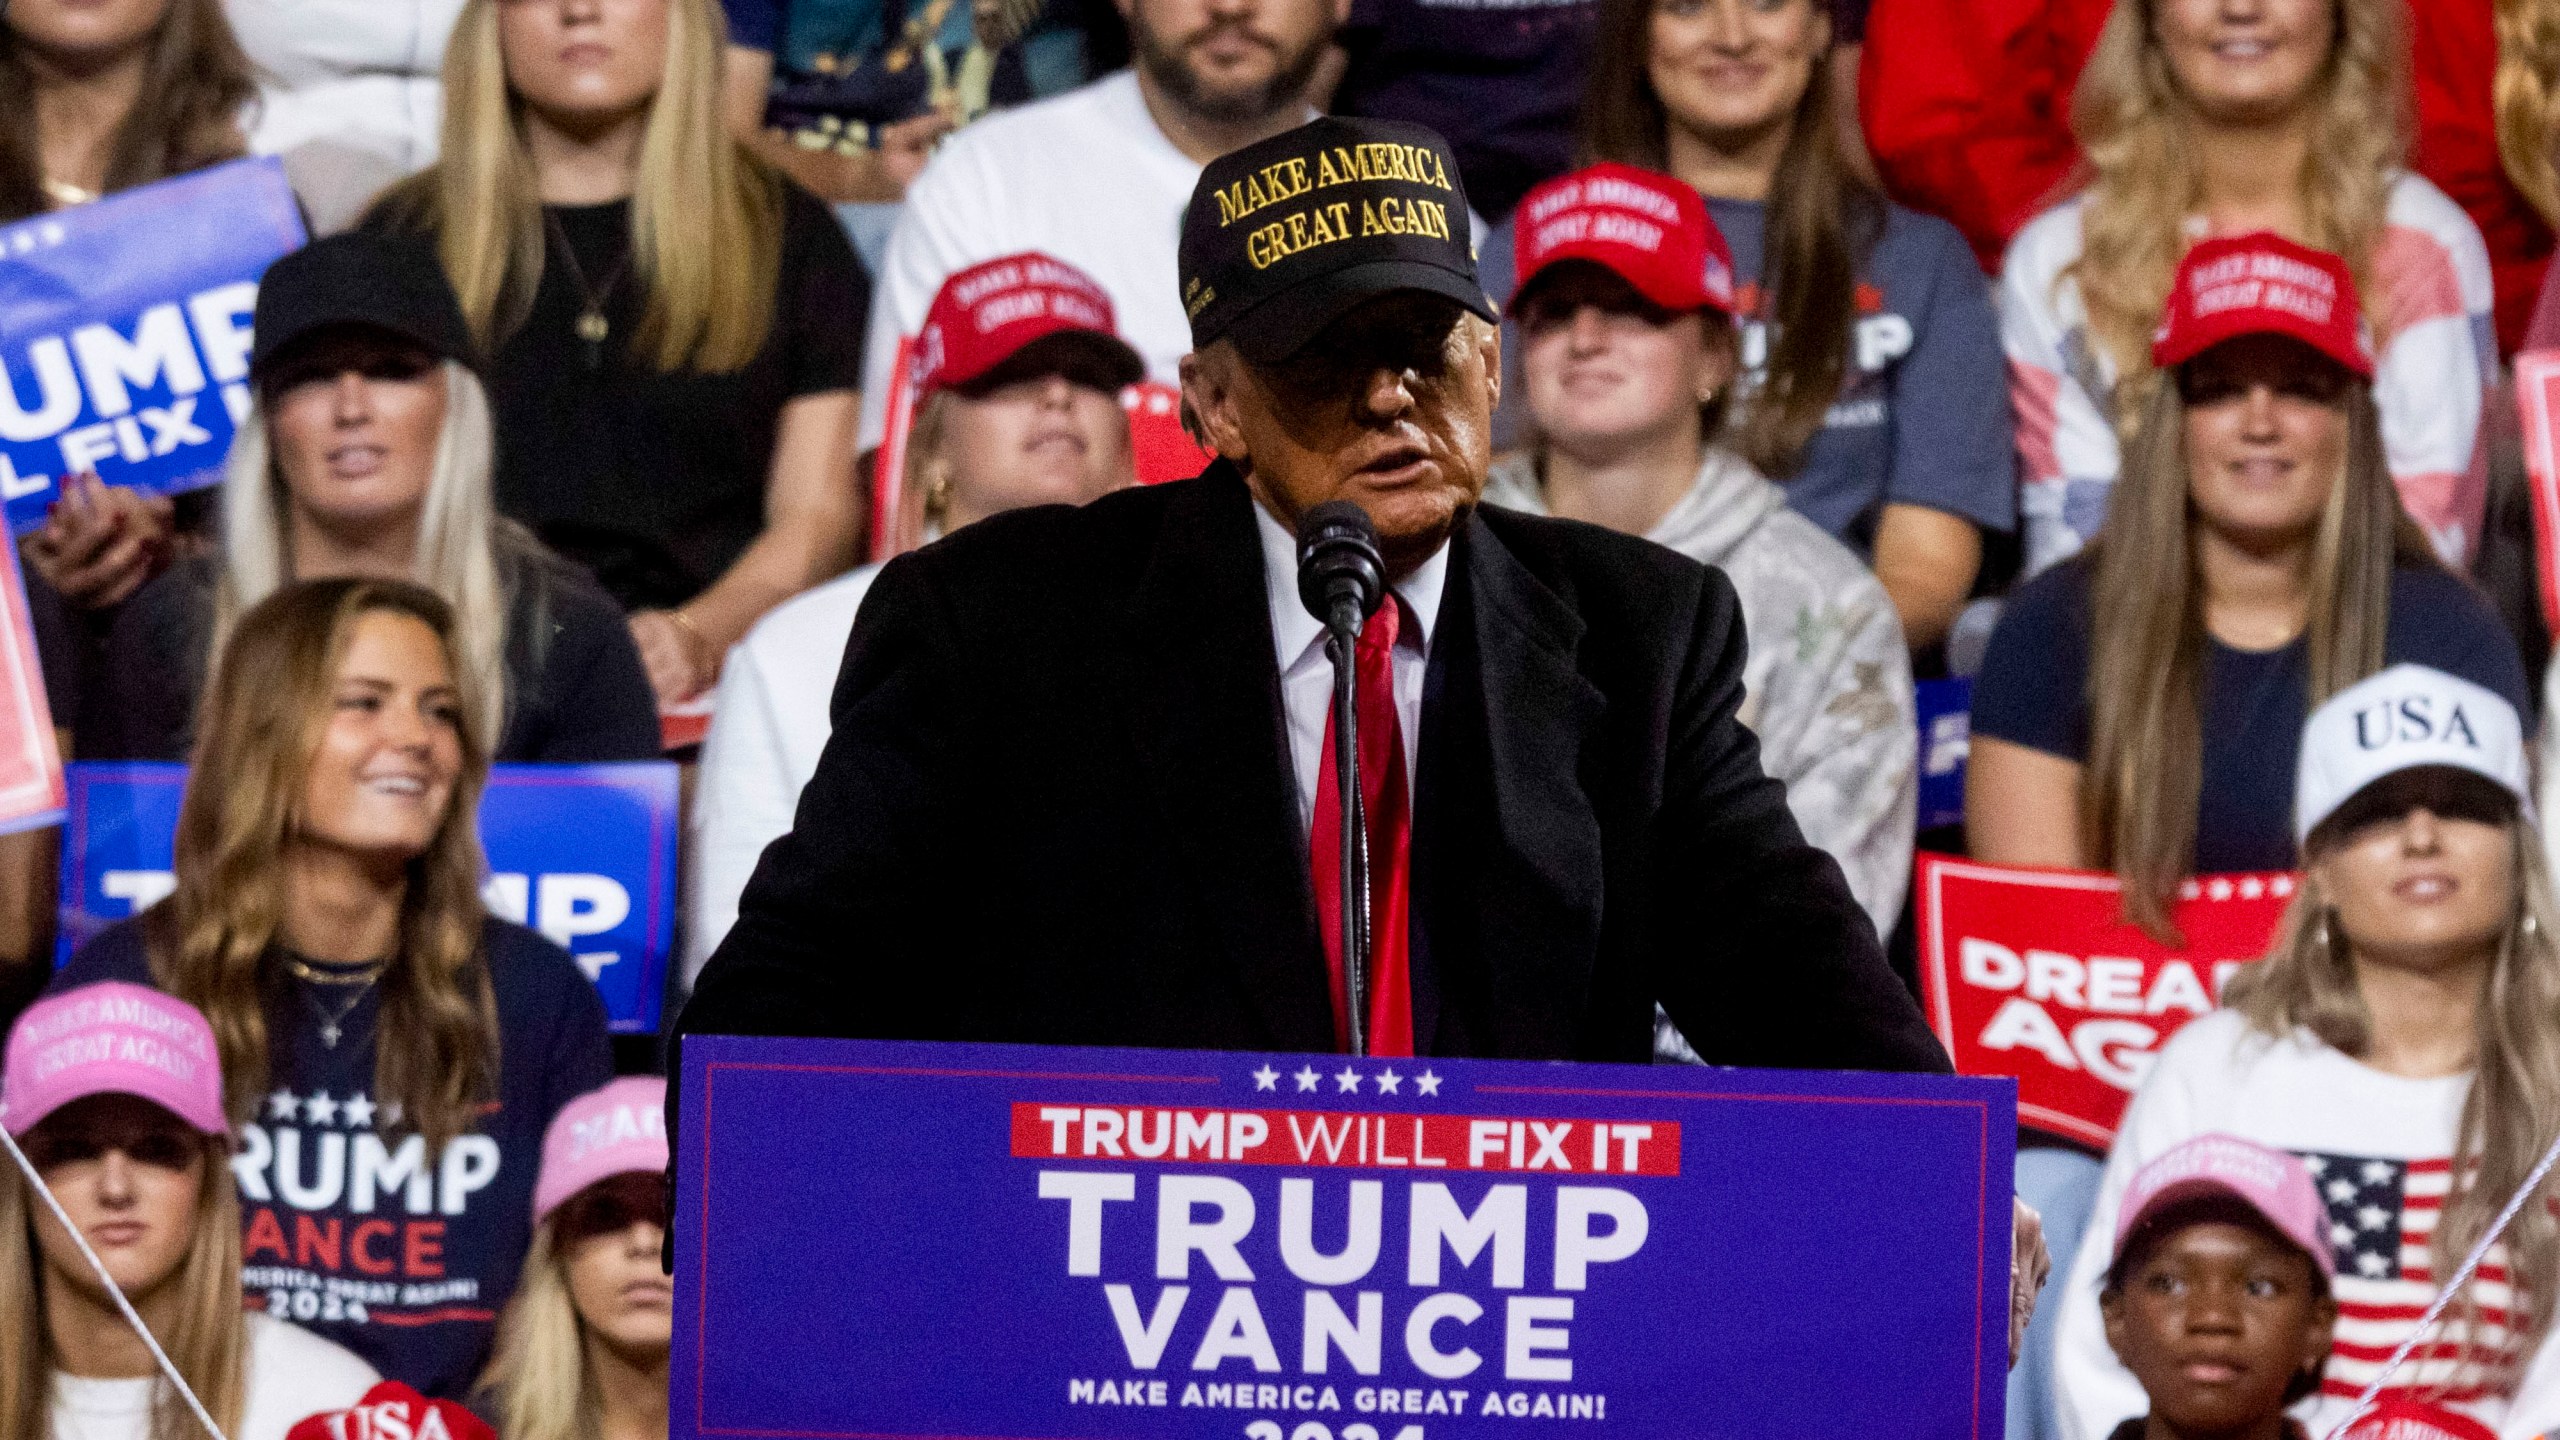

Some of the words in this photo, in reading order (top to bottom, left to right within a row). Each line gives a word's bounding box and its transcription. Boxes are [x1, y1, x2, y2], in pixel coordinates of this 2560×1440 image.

[1214, 156, 1312, 228] MAKE
[1317, 142, 1452, 191] AMERICA
[1248, 201, 1352, 270] GREAT
[1362, 197, 1450, 241] AGAIN
[58, 396, 212, 475] FIX
[2354, 697, 2479, 751] USA
[1040, 1107, 1269, 1161] TRUMP
[1287, 1114, 1447, 1167] WILL
[1468, 1120, 1572, 1171] FIX
[1592, 1123, 1653, 1173] IT
[1038, 1170, 1650, 1292] TRUMP
[267, 1287, 370, 1324] 2024
[1103, 1284, 1575, 1382] VANCE
[325, 1400, 455, 1440] USA
[1069, 1378, 1168, 1407] MAKE
[1181, 1382, 1341, 1412] AMERICA
[1354, 1388, 1470, 1415] GREAT
[1482, 1392, 1607, 1419] AGAIN!
